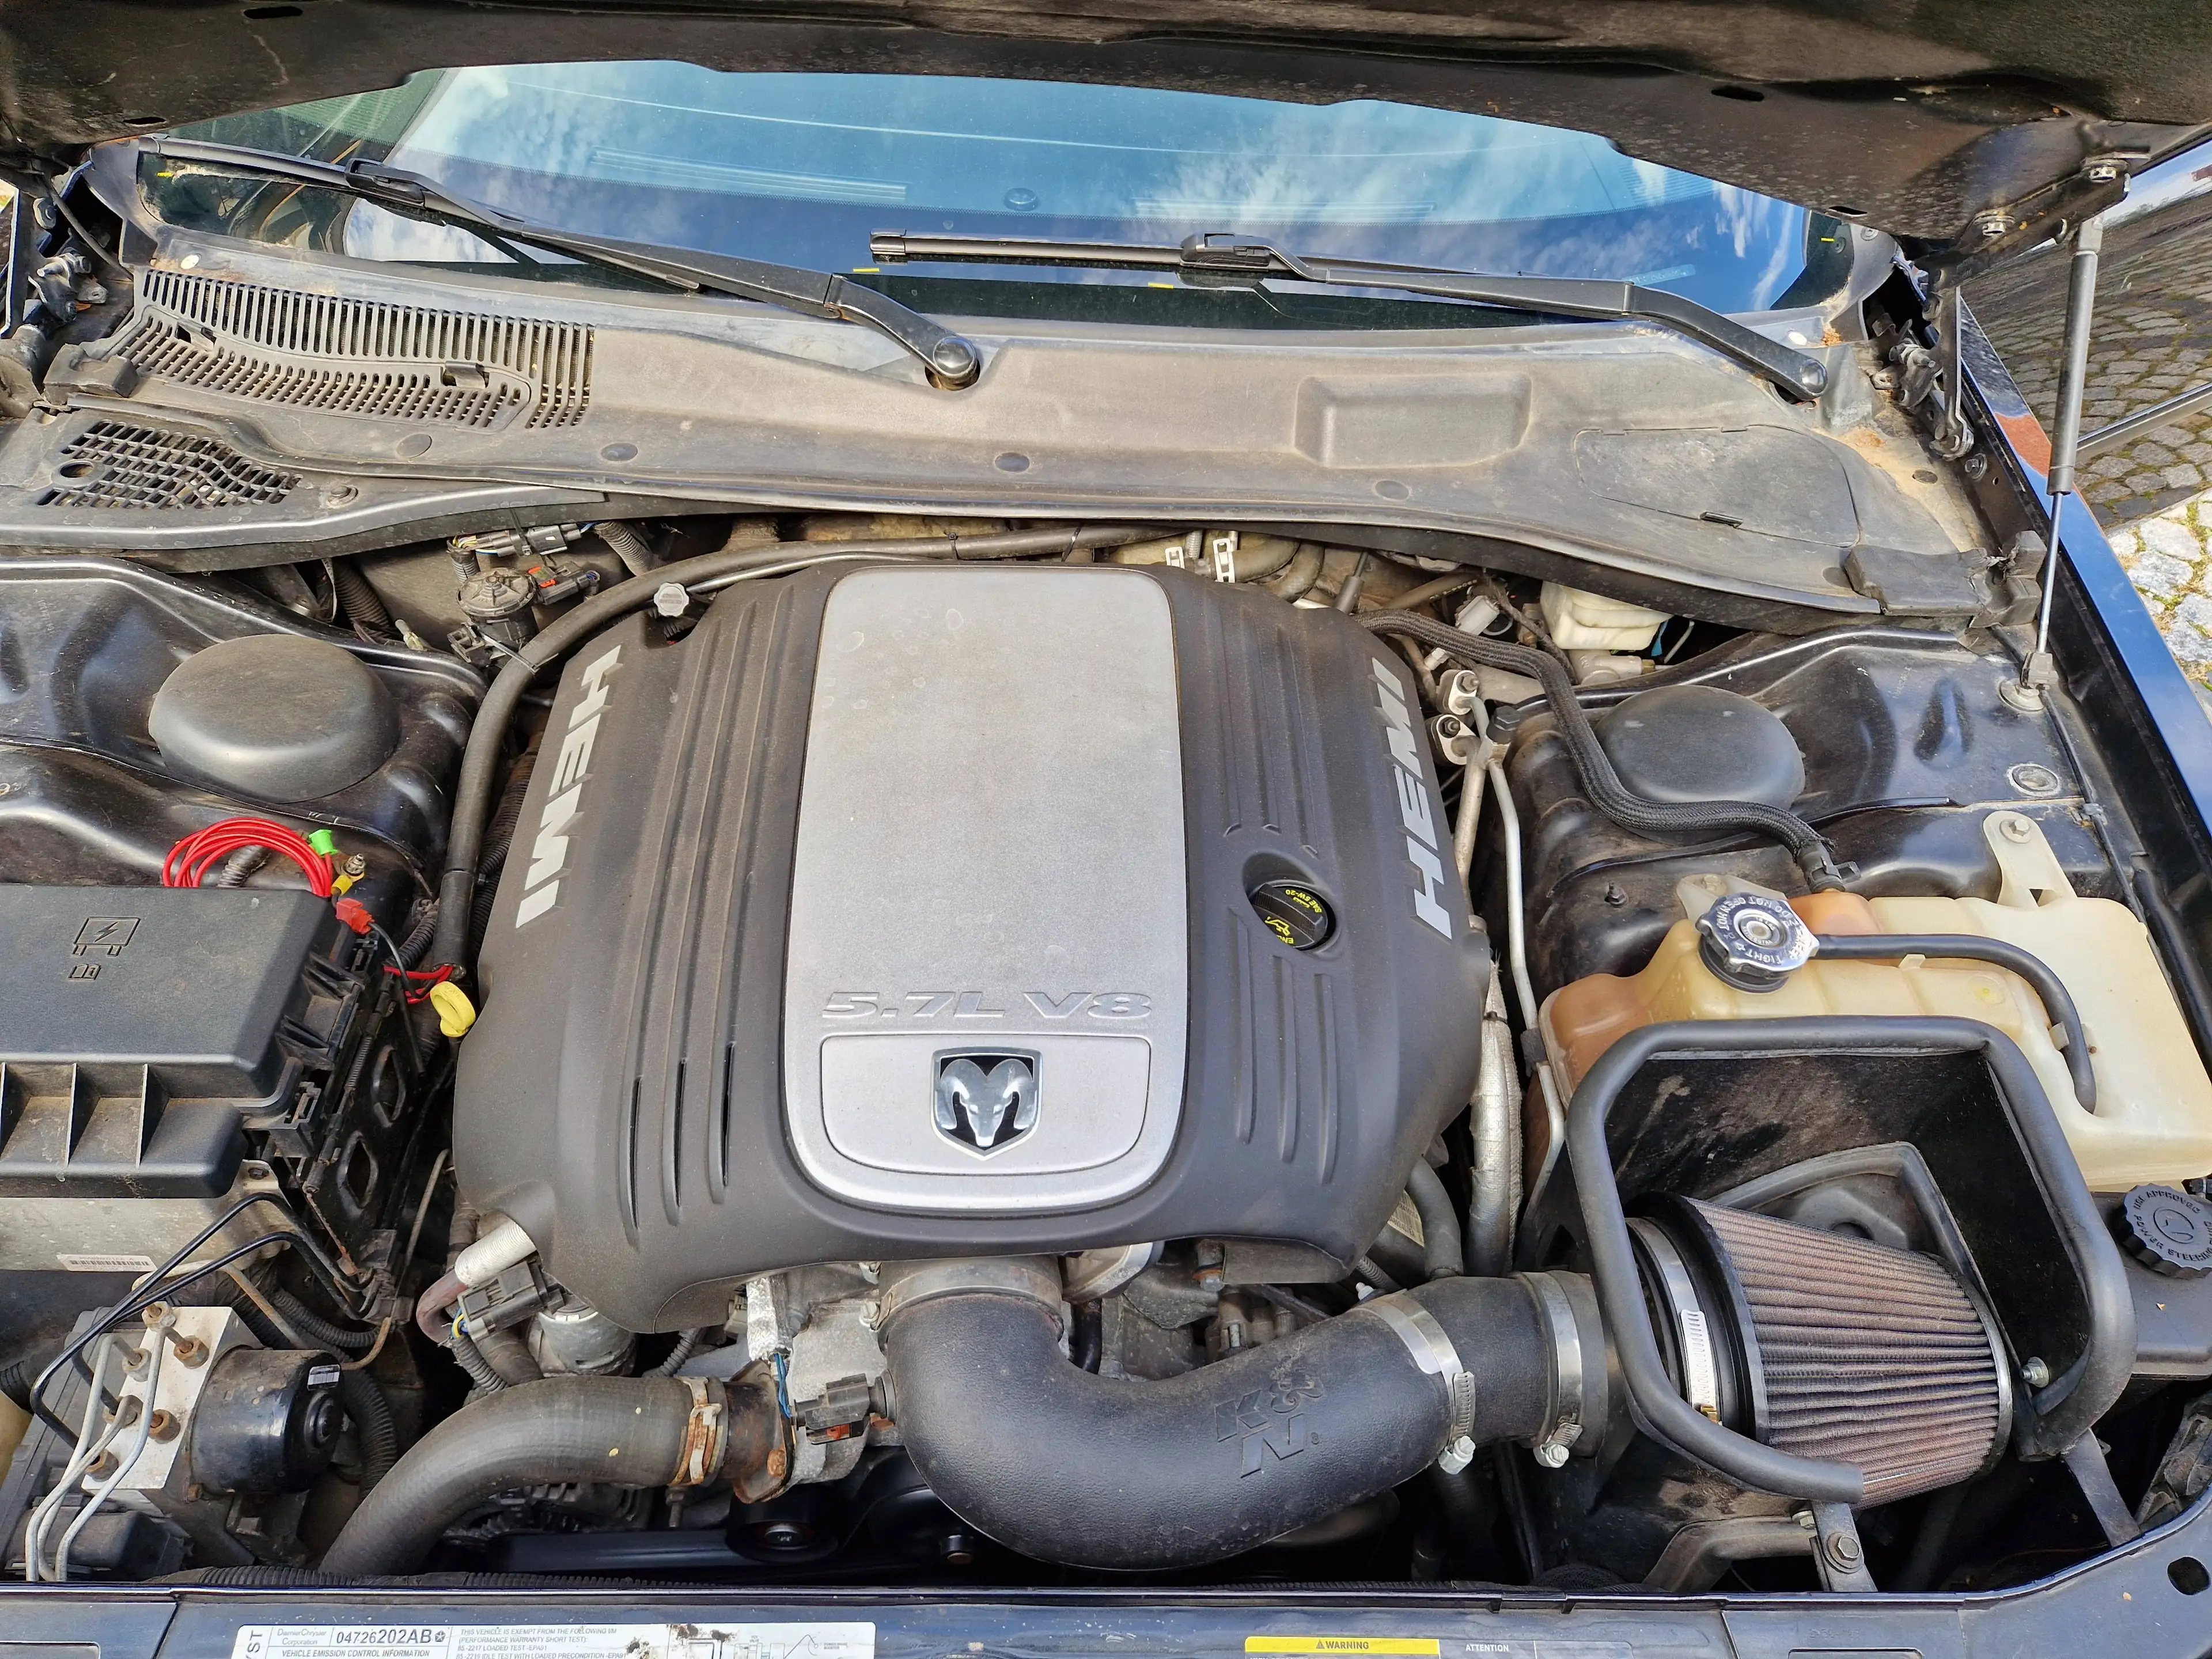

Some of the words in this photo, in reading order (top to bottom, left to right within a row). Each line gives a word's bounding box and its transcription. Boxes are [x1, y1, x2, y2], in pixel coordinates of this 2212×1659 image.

[515, 645, 622, 929] HEMI
[1372, 657, 1452, 940] HEMI
[1285, 889, 1311, 902] 5W-20
[1748, 896, 1772, 908] NOT
[1308, 899, 1323, 913] SAE
[1723, 897, 1747, 914] OPEN
[1774, 904, 1792, 919] DO
[1716, 911, 1730, 931] HOT
[1745, 950, 1782, 965] TIGHT
[822, 991, 1005, 1018] 5.7L
[1023, 992, 1152, 1020] V8
[2133, 1195, 2146, 1210] USE
[2146, 1190, 2201, 1214] APPROVED
[2134, 1214, 2164, 1249] POWER
[282, 1638, 317, 1646] Corporation
[336, 1629, 432, 1643] 04726202AB
[1325, 1641, 1369, 1649] WARNING
[1465, 1644, 1509, 1652] ATTENTION
